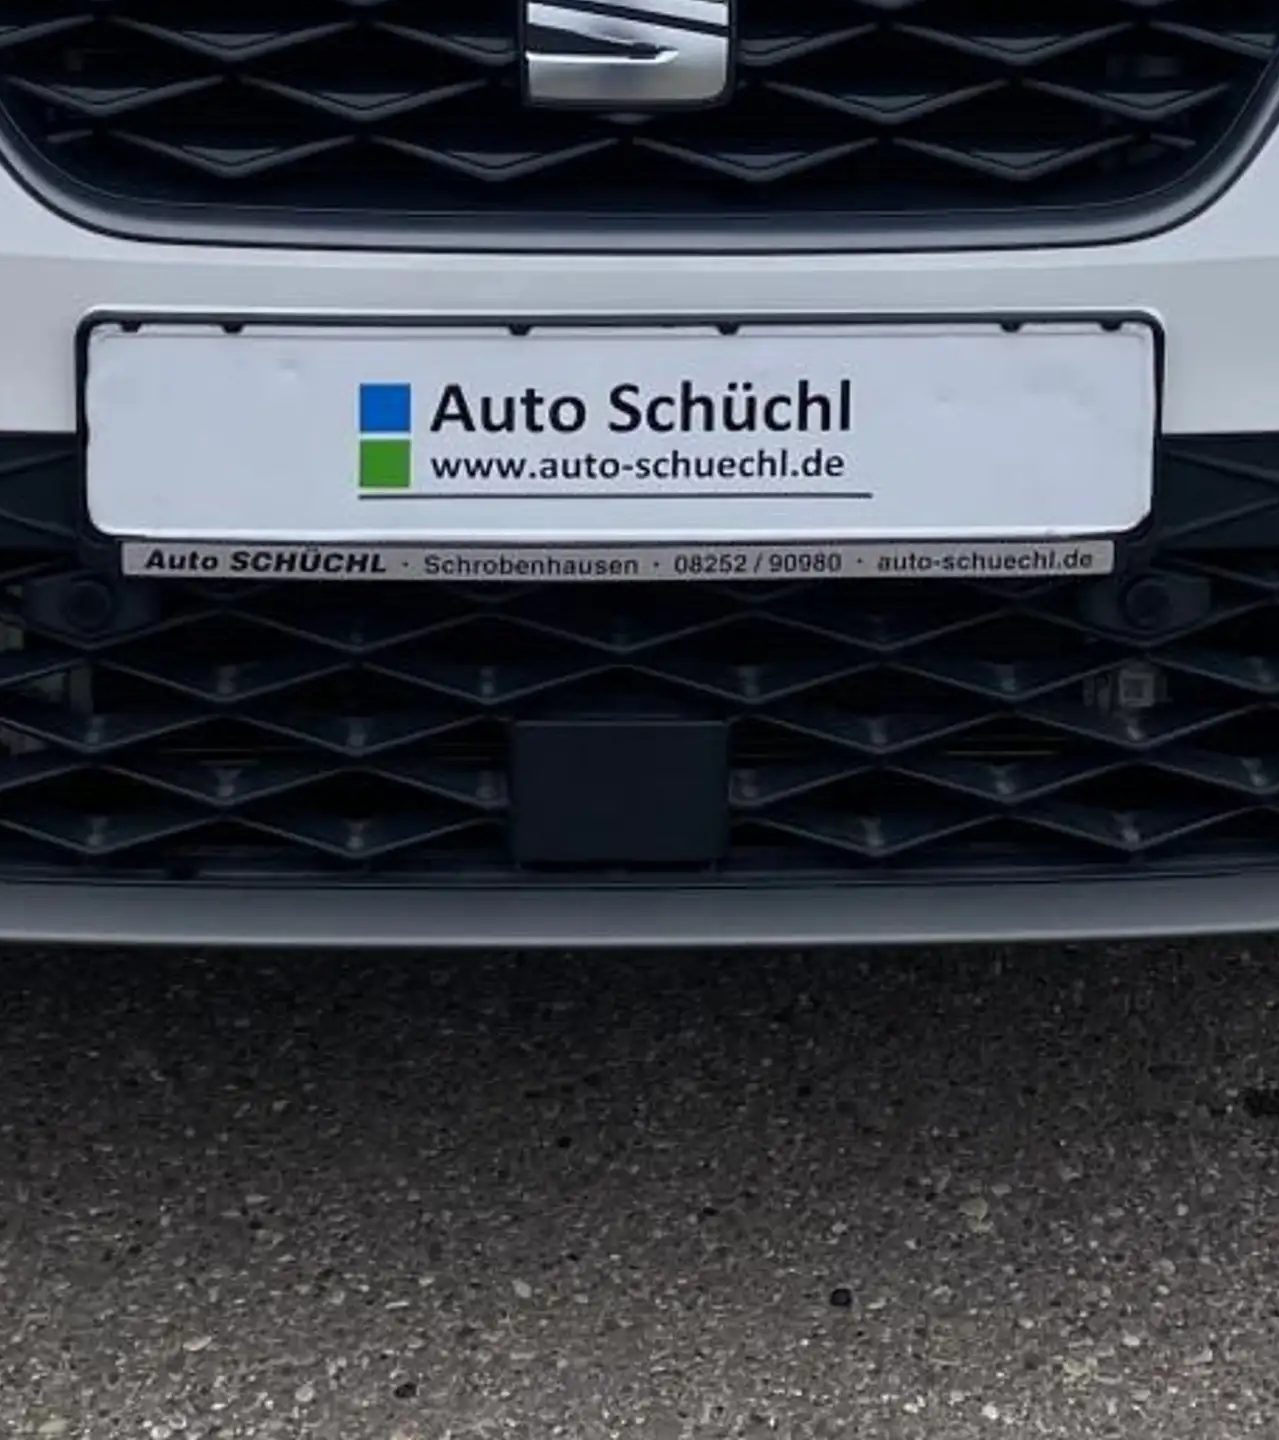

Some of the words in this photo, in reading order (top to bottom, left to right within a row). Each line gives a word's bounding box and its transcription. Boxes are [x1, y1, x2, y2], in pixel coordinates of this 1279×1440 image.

[429, 382, 587, 434] Auto
[607, 378, 852, 434] Schüchl
[430, 447, 846, 480] www.auto-schuechl.de
[145, 548, 218, 572] Auto
[229, 545, 387, 574] SCHÜCHL
[423, 555, 640, 577] Schrobenhausen
[673, 552, 747, 575] 08252
[767, 551, 842, 573] 90980
[876, 548, 1094, 573] auto-schuechl.de
